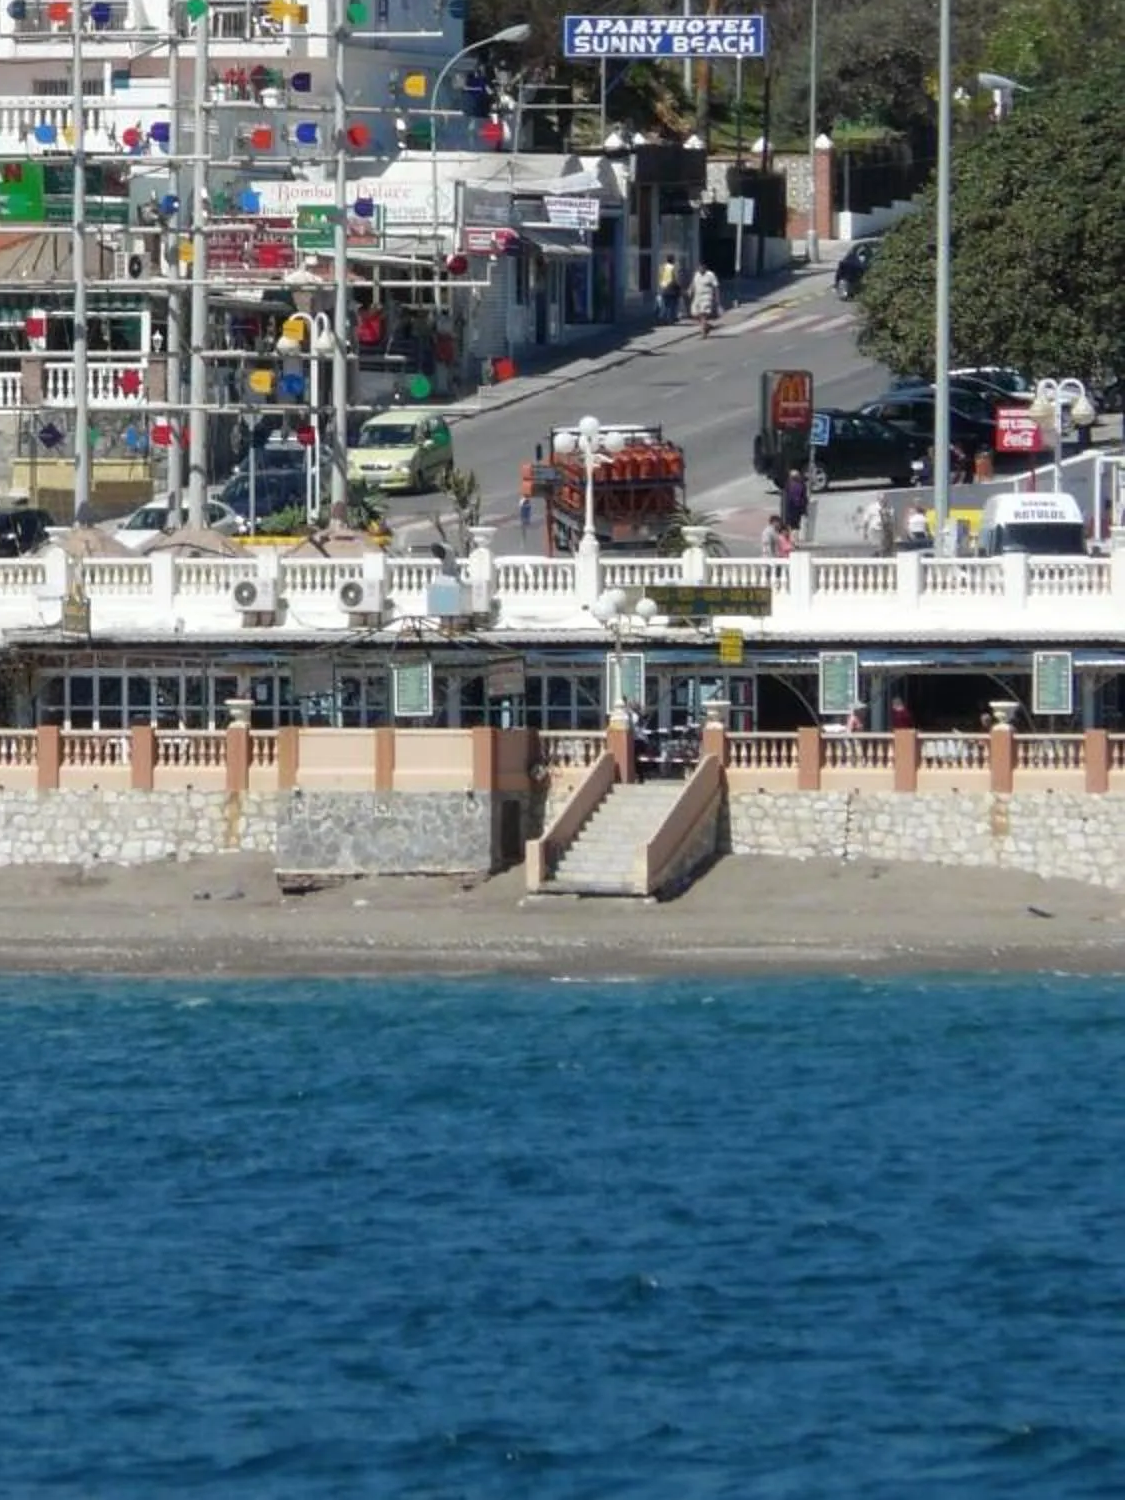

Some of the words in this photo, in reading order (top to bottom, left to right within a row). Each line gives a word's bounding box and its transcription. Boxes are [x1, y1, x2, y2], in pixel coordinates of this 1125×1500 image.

[575, 19, 755, 34] APARTHOTEL
[575, 36, 663, 53] SUNNY
[673, 36, 755, 53] BEACH
